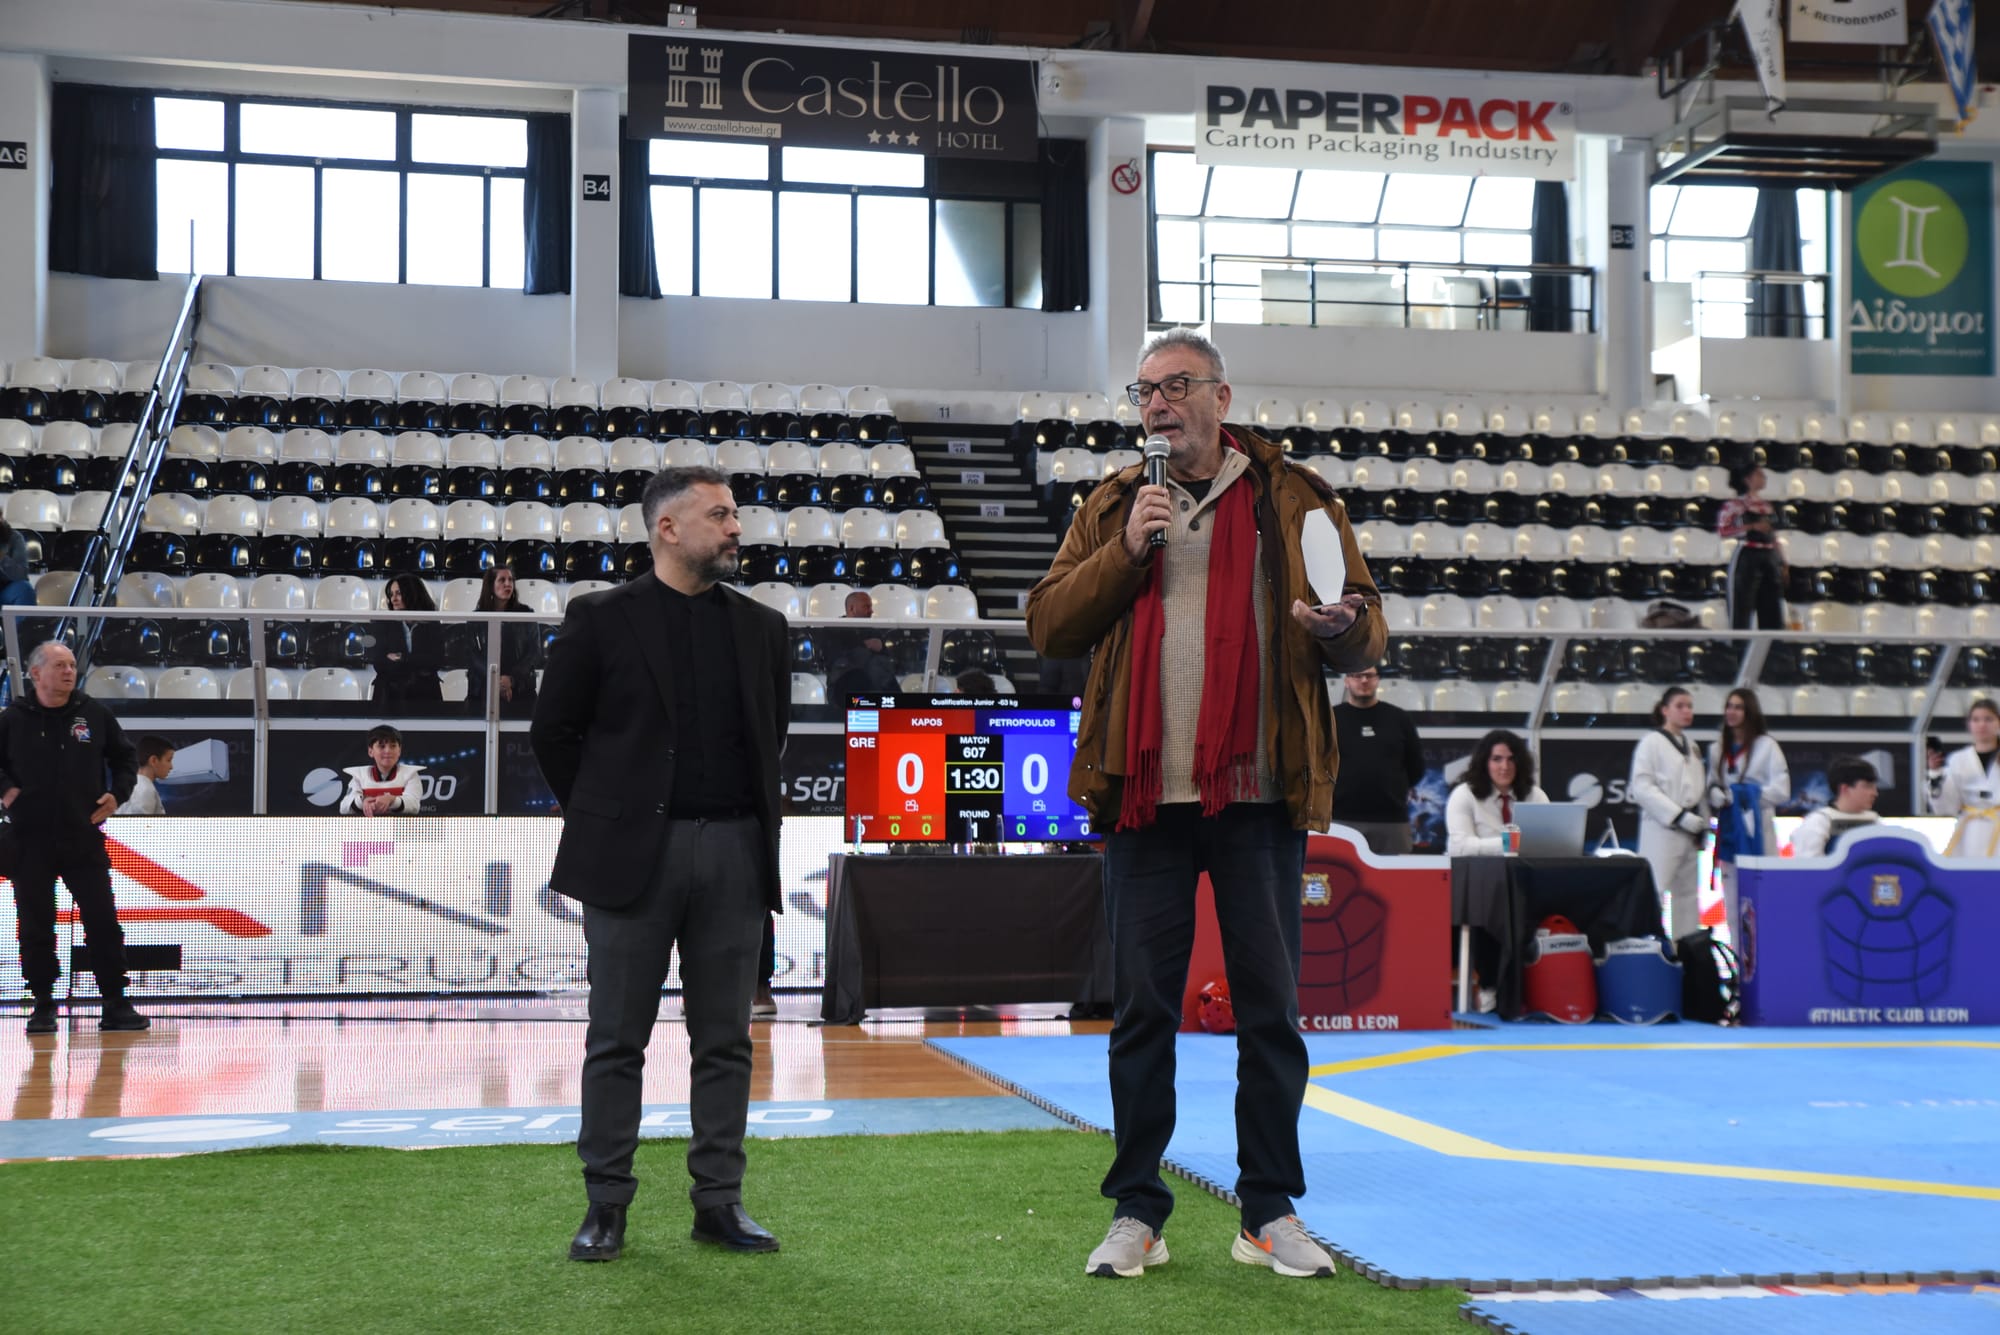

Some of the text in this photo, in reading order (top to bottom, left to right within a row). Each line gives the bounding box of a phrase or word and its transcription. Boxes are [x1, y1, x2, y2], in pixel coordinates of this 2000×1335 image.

[741, 57, 1004, 125] Castello
[668, 119, 777, 137] www.castellohotel.gr
[937, 132, 1004, 151] HOTEL
[1205, 128, 1557, 166] Carton Packaging Industry
[1848, 298, 1985, 345] Δίδυμοι
[939, 407, 950, 418] 11
[931, 699, 973, 707] Qualification
[1009, 699, 1018, 707] kg
[911, 718, 943, 727] KAPOS
[989, 718, 1056, 727] PETROPOULOS
[849, 738, 876, 748] GRE
[959, 736, 990, 745] MATCH
[963, 747, 986, 759] 607
[896, 753, 924, 795] 0
[951, 768, 1000, 789] 1:30
[1022, 753, 1049, 795] 0
[959, 810, 990, 818] ROUND
[890, 823, 900, 836] 0
[922, 823, 931, 836] 0
[970, 822, 978, 838] 1
[1016, 823, 1026, 835] 0
[1049, 823, 1058, 835] 0
[1313, 1015, 1353, 1029] CLUB
[1357, 1015, 1399, 1029] LEON
[1810, 1008, 1969, 1023] ATHLETIC CLUB LEON
